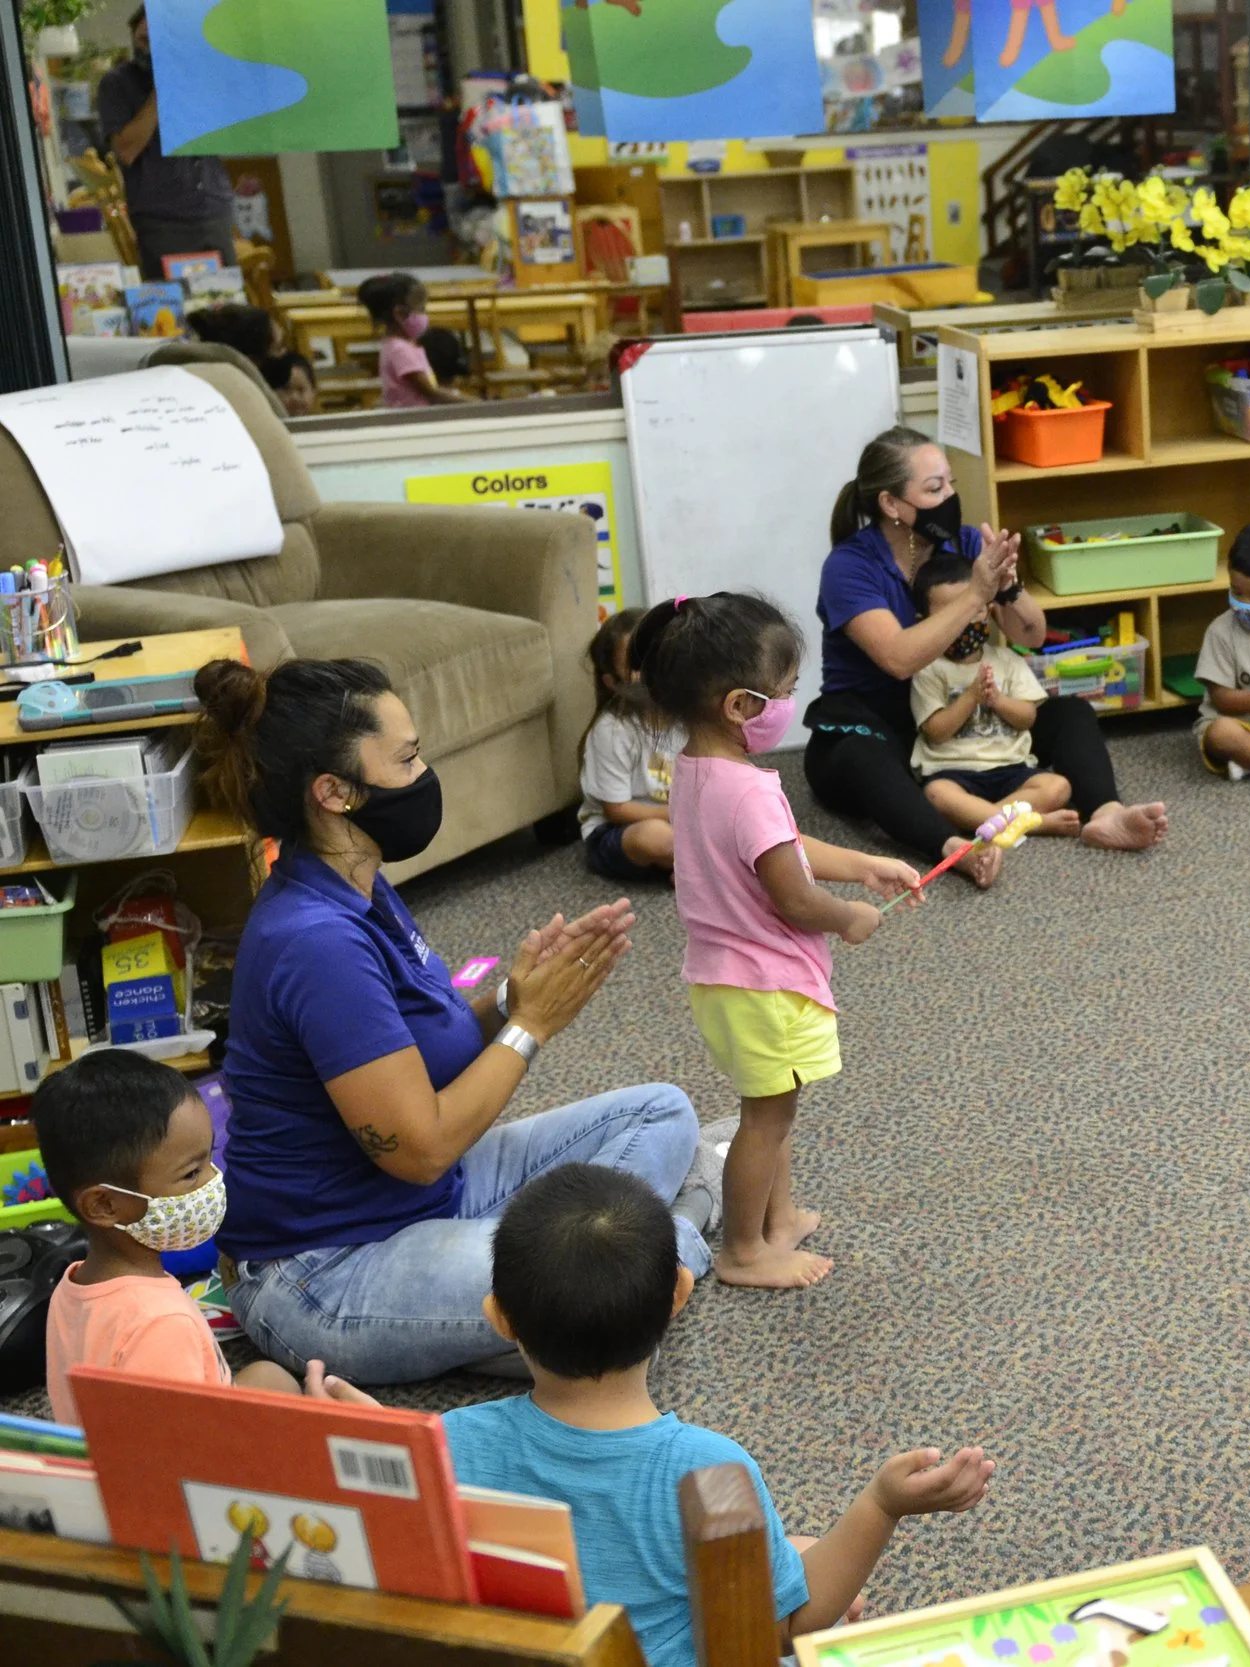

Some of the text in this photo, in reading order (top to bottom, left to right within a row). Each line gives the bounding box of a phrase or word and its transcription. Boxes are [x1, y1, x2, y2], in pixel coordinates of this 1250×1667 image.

[472, 473, 548, 494] Colors
[115, 953, 149, 974] 35
[113, 994, 166, 1006] chicken
[115, 985, 163, 998] dance
